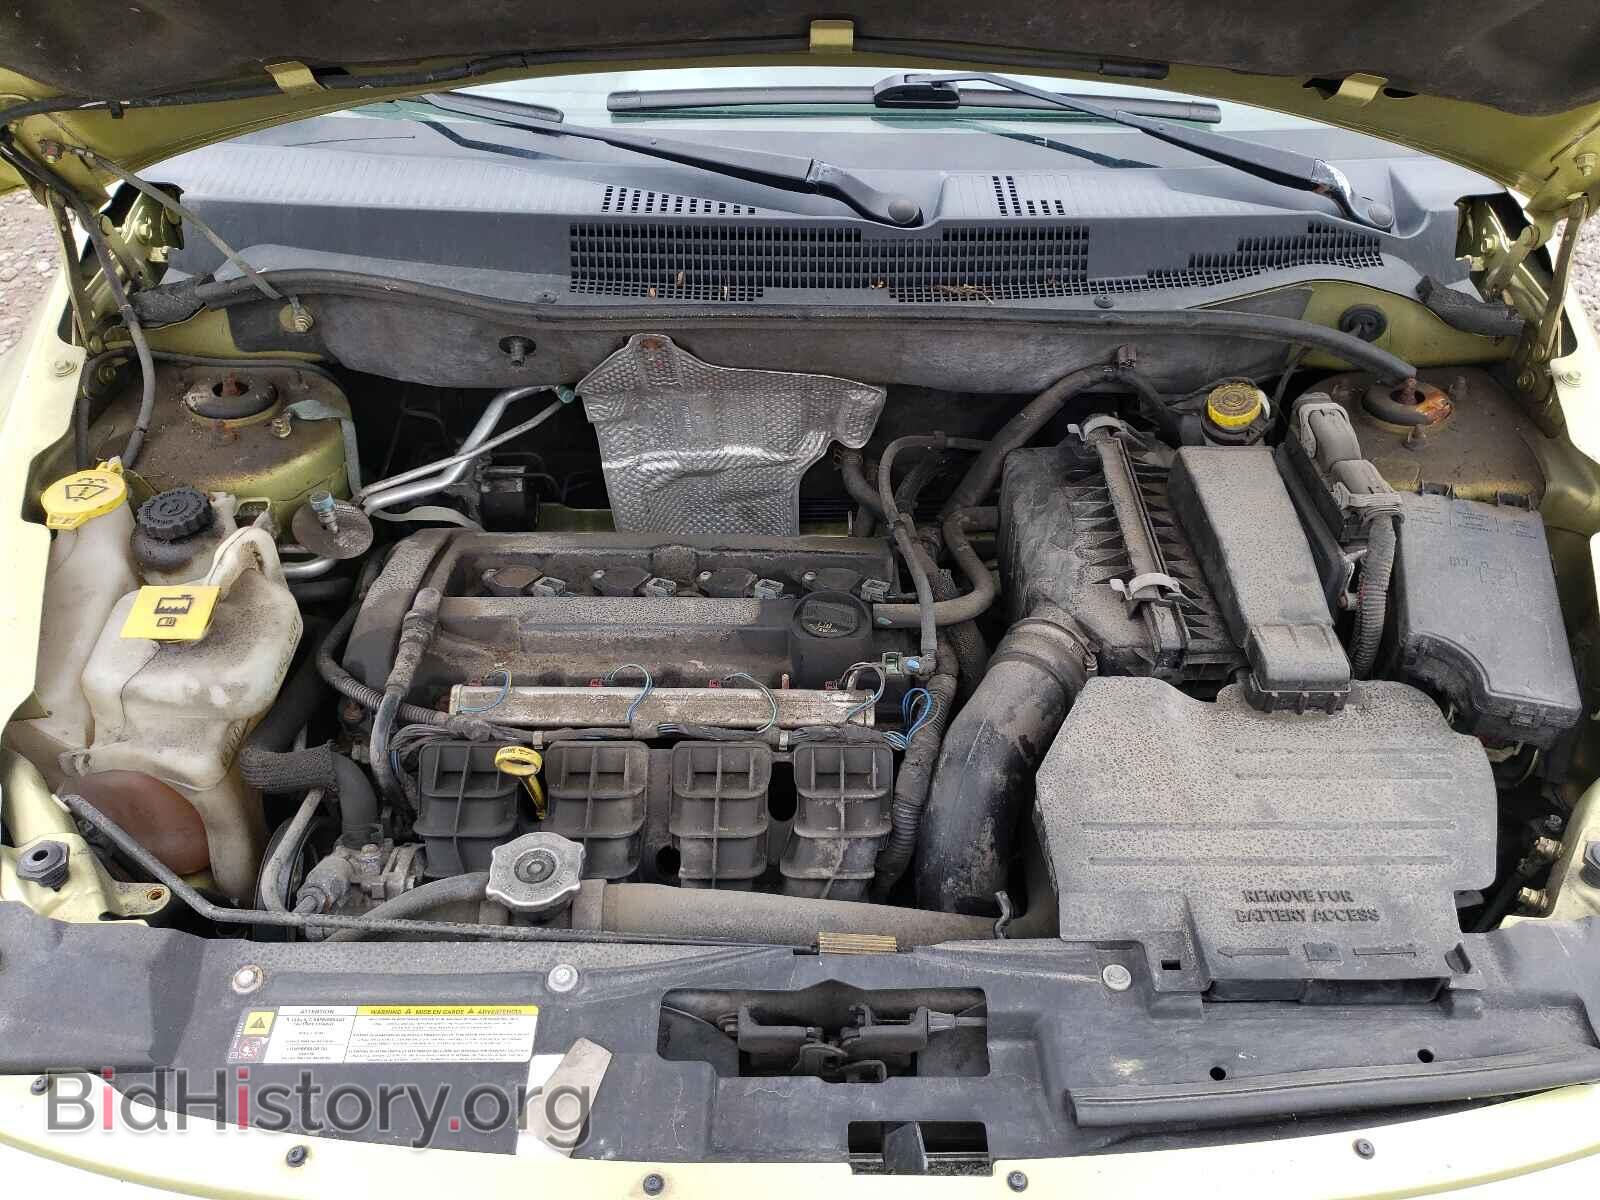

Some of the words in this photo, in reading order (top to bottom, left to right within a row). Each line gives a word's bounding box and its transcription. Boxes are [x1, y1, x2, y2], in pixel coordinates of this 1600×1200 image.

[1243, 889, 1315, 903] REMOVE
[1317, 889, 1355, 903] FOR
[1235, 908, 1307, 923] BATTERY
[1312, 908, 1380, 923] ACCESS
